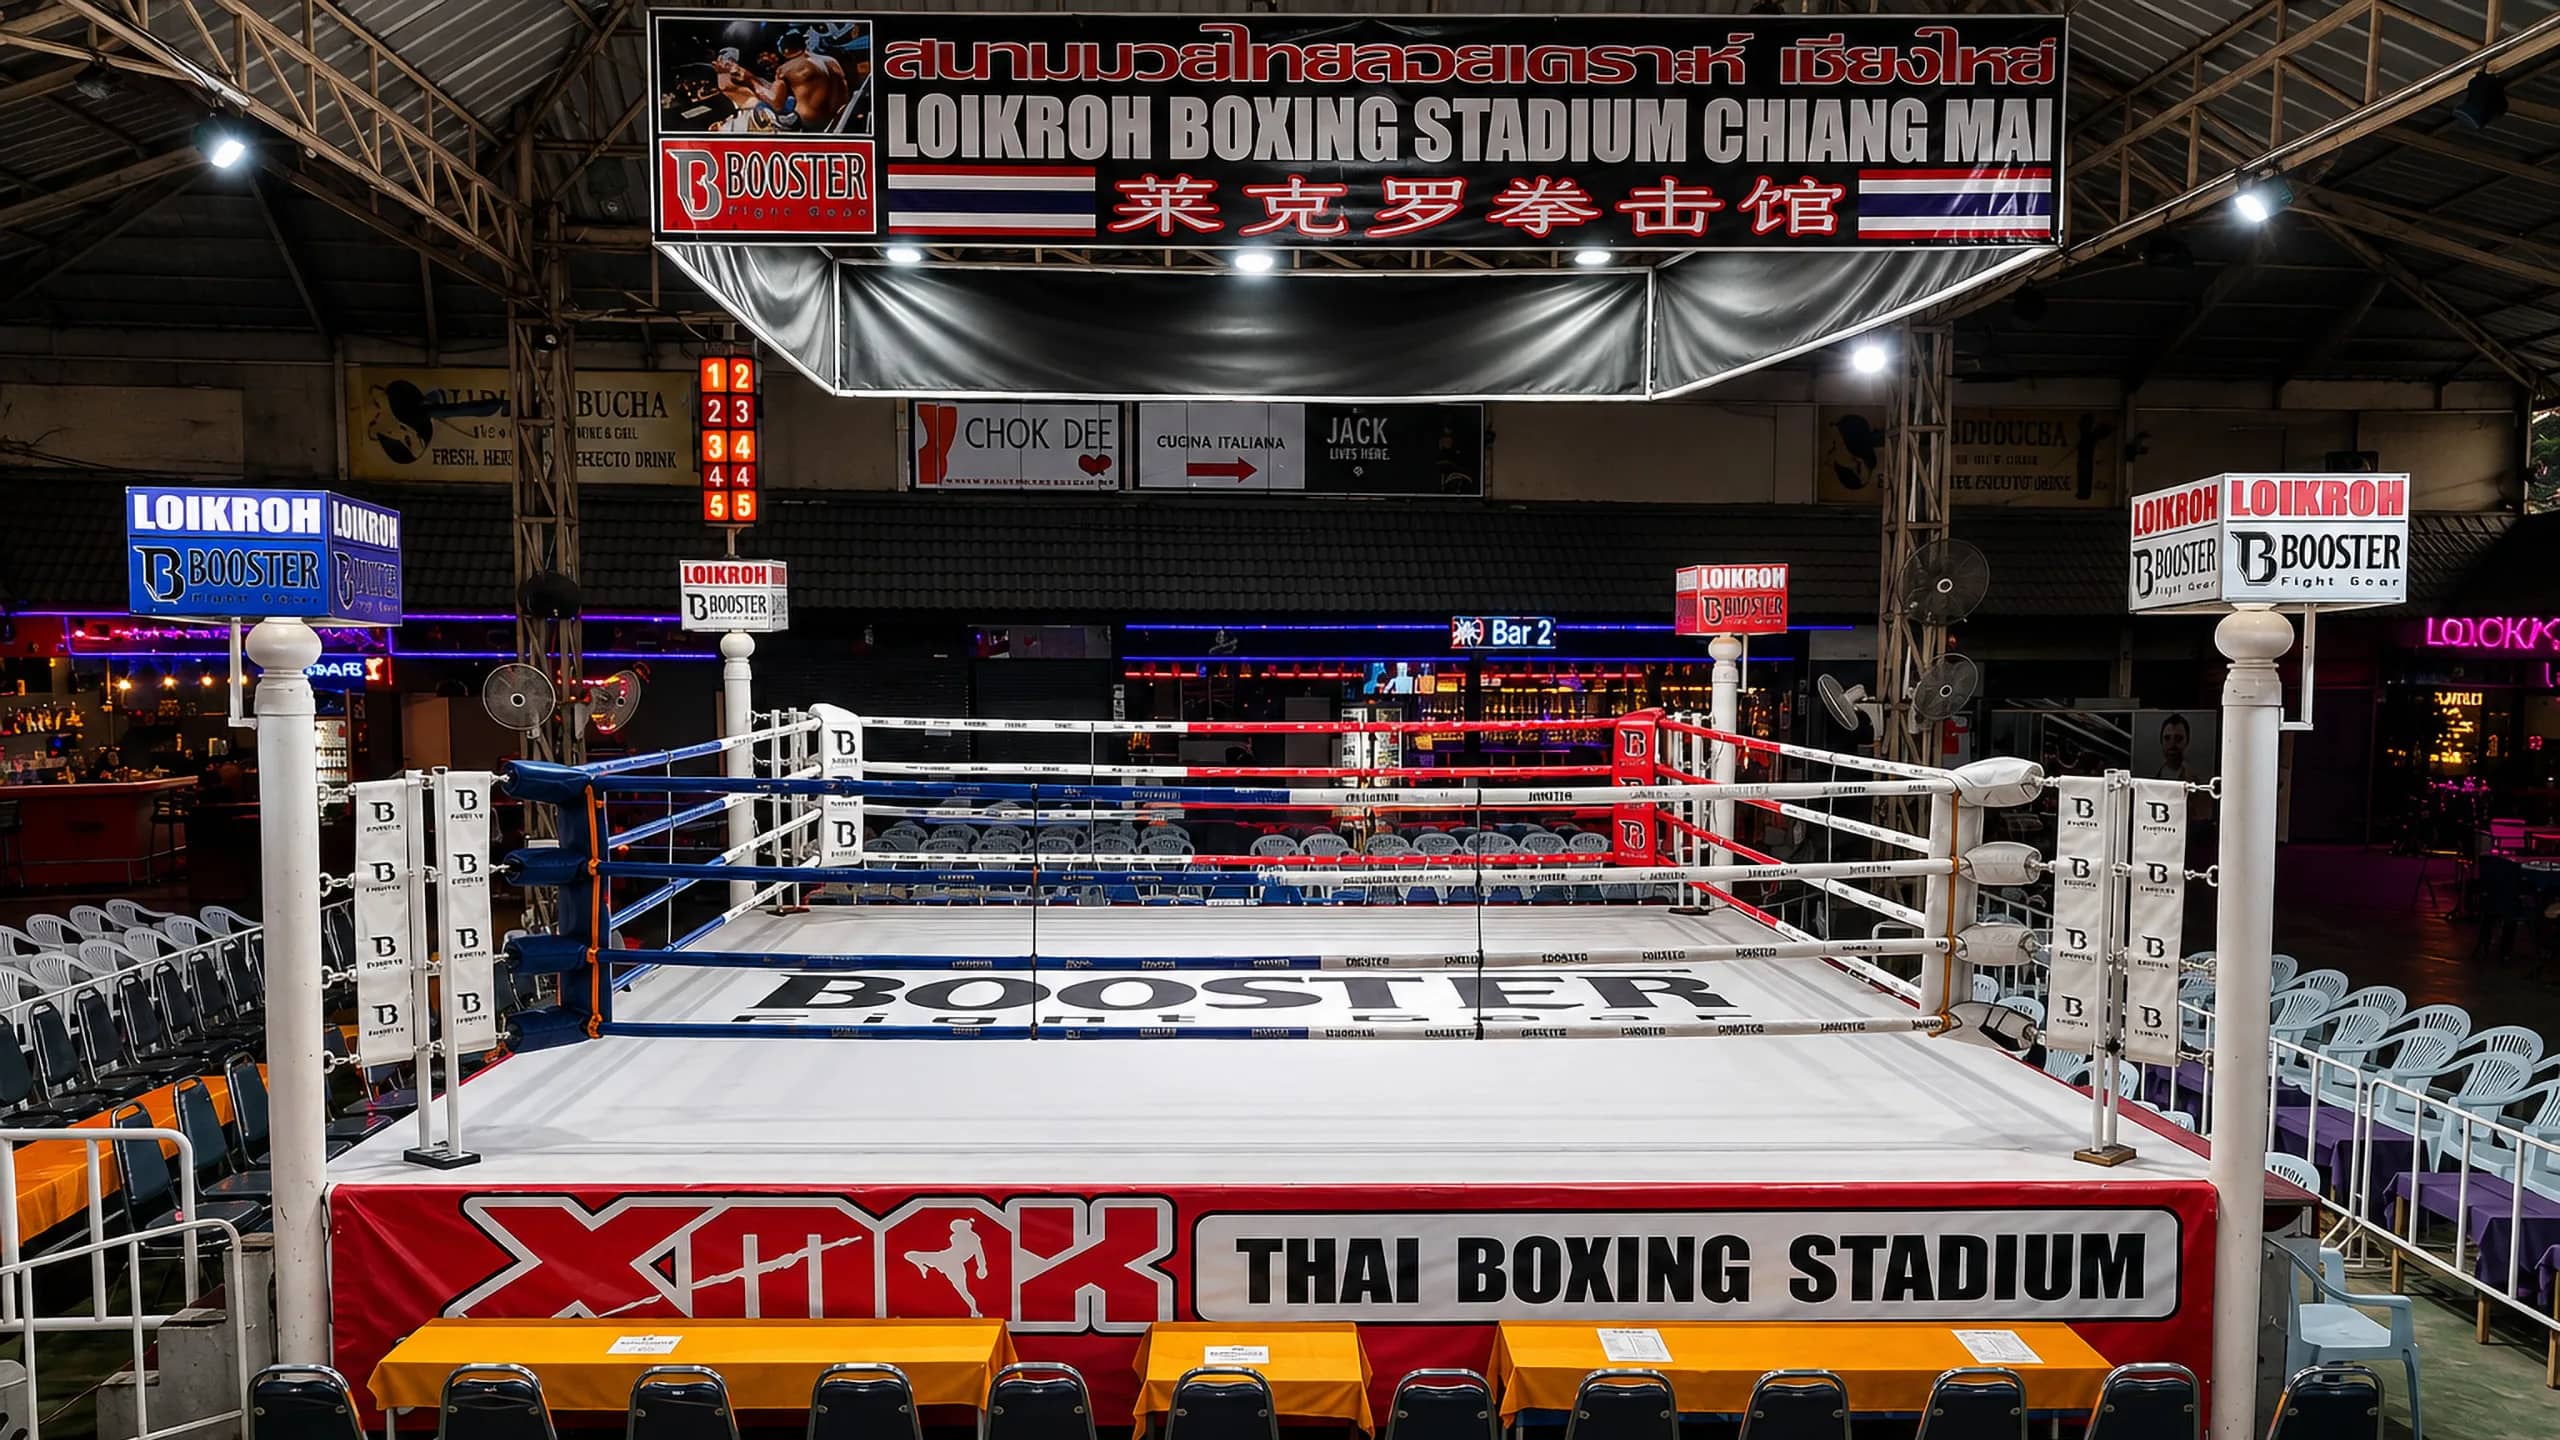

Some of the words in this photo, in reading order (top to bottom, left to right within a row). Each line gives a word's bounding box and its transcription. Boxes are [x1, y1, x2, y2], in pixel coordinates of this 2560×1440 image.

[886, 94, 1152, 161] LOIKROH
[1168, 95, 1398, 162] BOXING
[1414, 97, 1687, 163] STADIUM
[1703, 97, 1929, 163] CHIANG
[1944, 98, 2053, 163] MAI
[725, 151, 867, 200] BOOSTER
[1107, 173, 1846, 239] 莱克罗拳击馆
[707, 363, 719, 388] 1
[735, 363, 749, 389] 2
[576, 390, 669, 418] BUCHA
[708, 399, 722, 422] 2
[736, 400, 748, 423] 3
[966, 418, 1050, 449] CHOK
[1065, 419, 1113, 449] DEE
[1157, 435, 1211, 448] CUCINA
[1218, 437, 1285, 449] ITALIANA
[1326, 417, 1387, 444] JACK
[635, 452, 677, 468] DRINK
[708, 434, 723, 459] 3
[735, 435, 751, 459] 4
[709, 466, 724, 487] 4
[736, 466, 749, 487] 4
[737, 493, 751, 517] 5
[2134, 484, 2218, 537] LOIKROH
[2230, 479, 2404, 517] LOIKROH
[133, 494, 320, 533] LOIKROH
[332, 501, 398, 549] LOIKROH
[2155, 538, 2216, 581] BOOSTER
[2281, 534, 2401, 570] BOOSTER
[189, 549, 320, 589] BOOSTER
[684, 565, 767, 585] LOIKROH
[1701, 568, 1785, 589] LOIKROH
[2281, 576, 2334, 588] Fight
[709, 594, 767, 613] BOOSTER
[1492, 620, 1531, 645] Bar
[1537, 620, 1551, 645] 2
[748, 974, 1737, 1010] BOOSTER
[1235, 1237, 1420, 1306] THAI
[1456, 1234, 1751, 1305] BOXING
[1789, 1233, 2147, 1304] STADIUM
